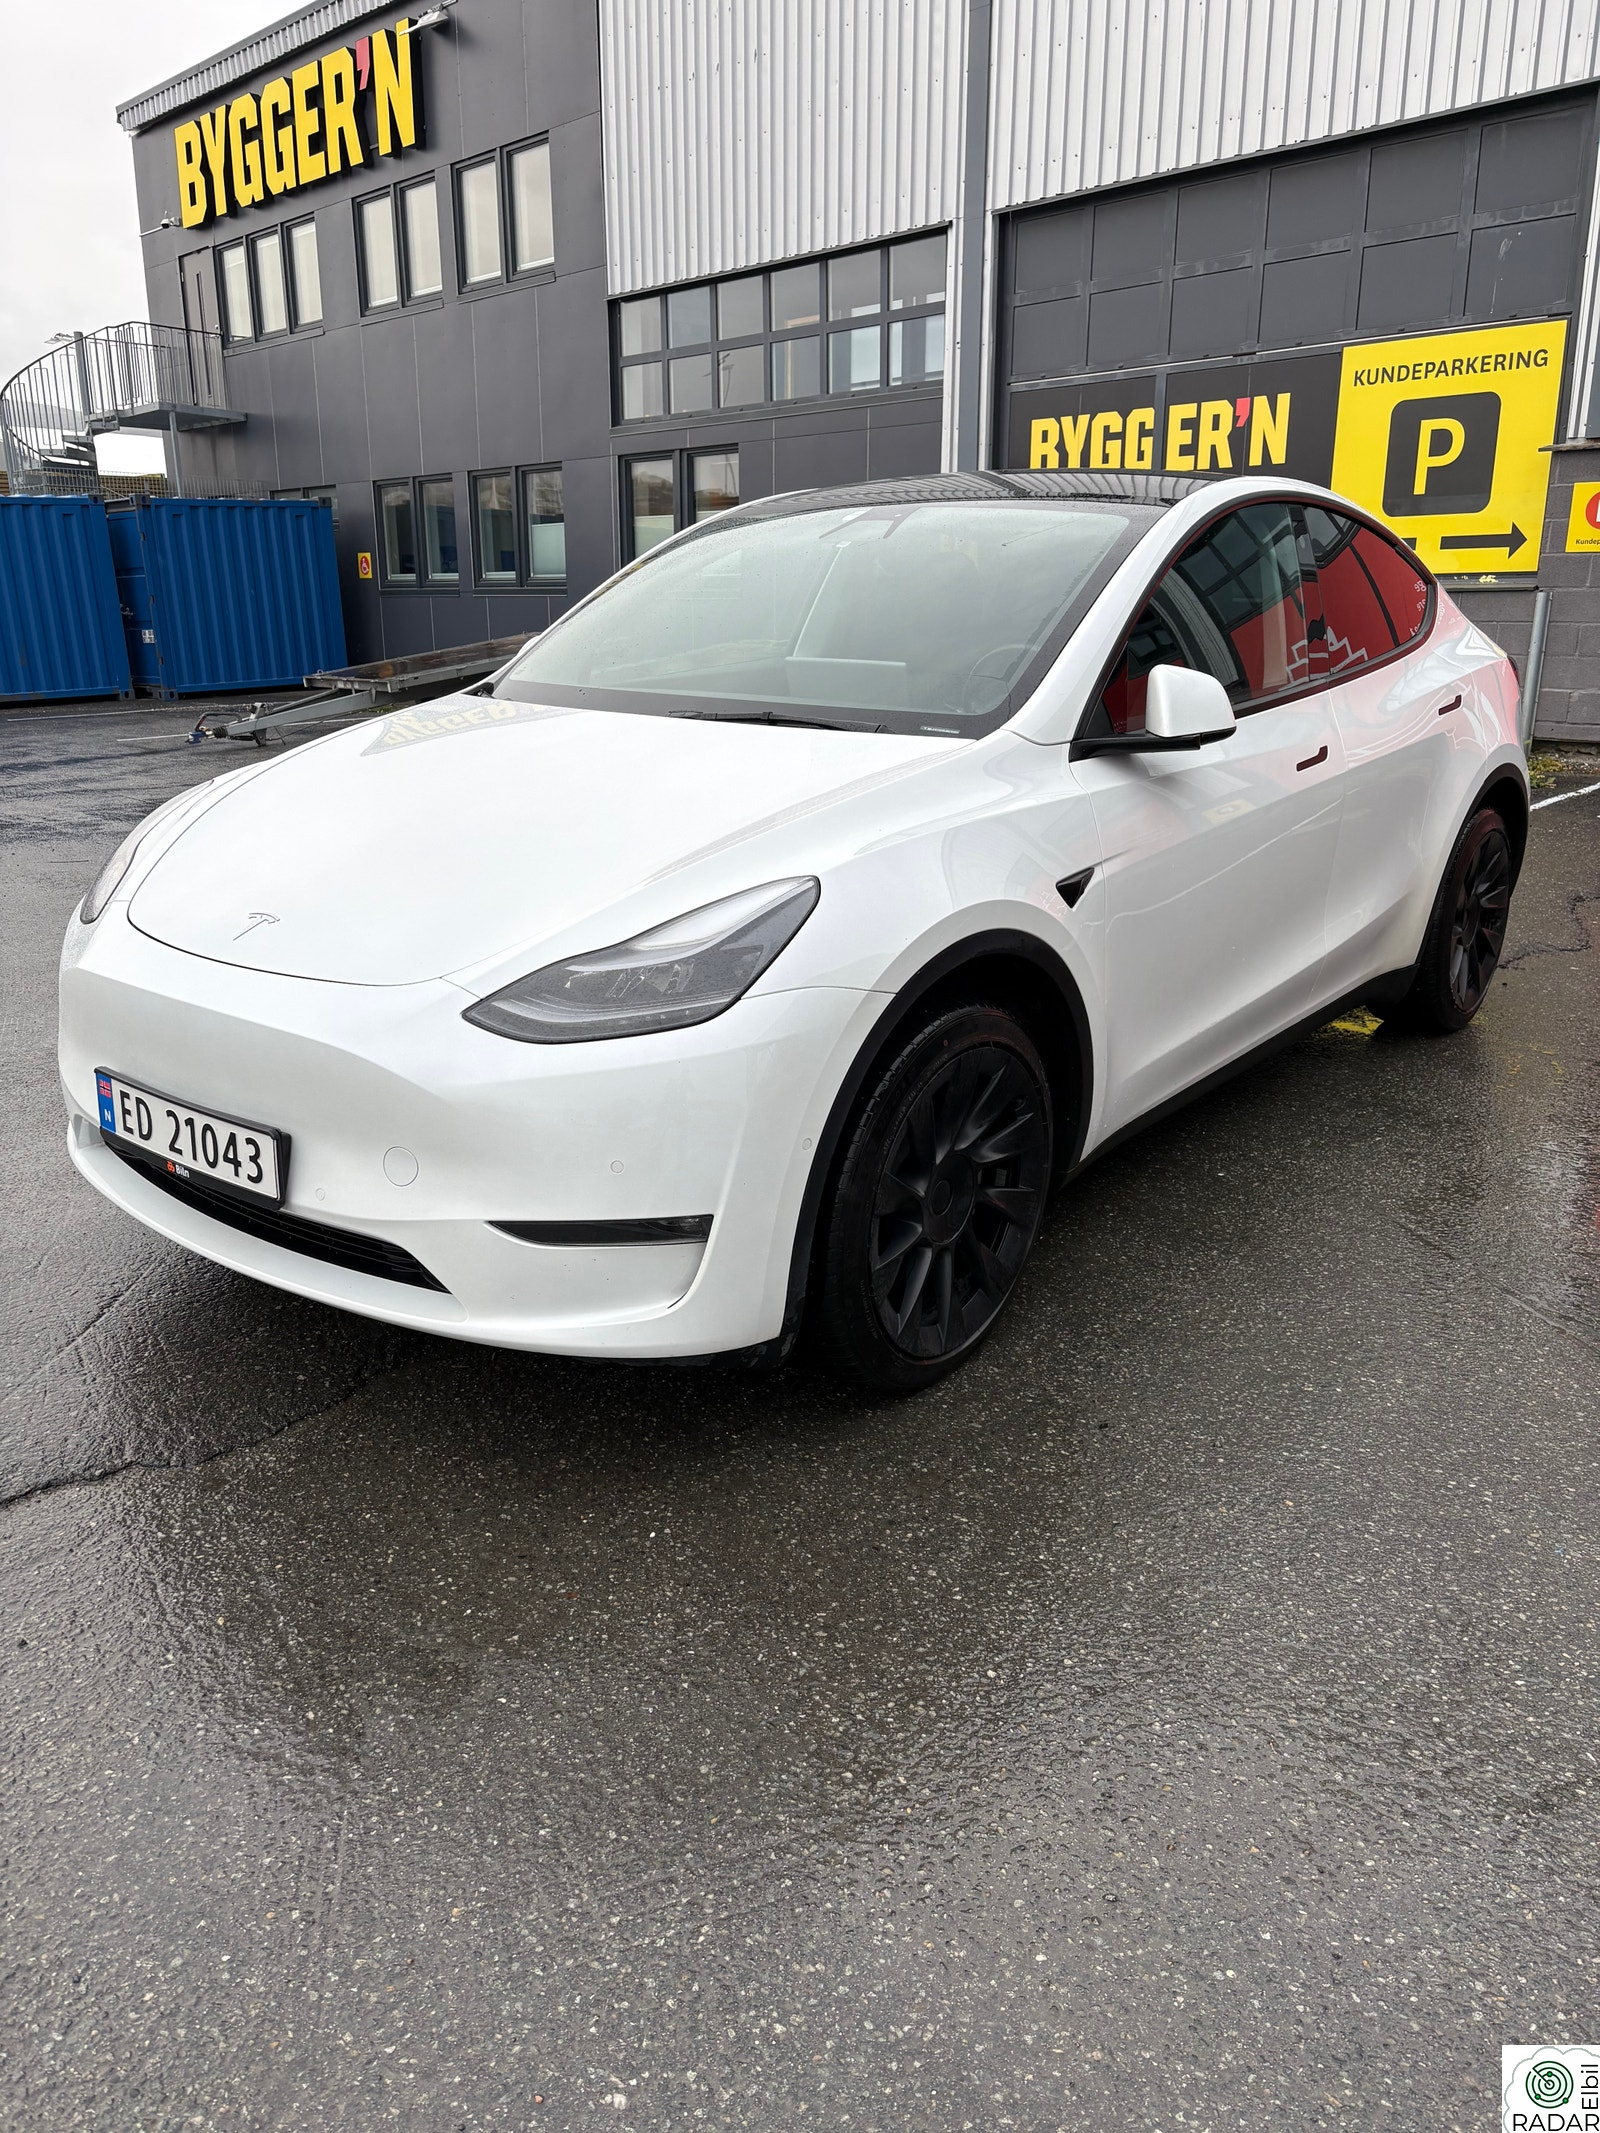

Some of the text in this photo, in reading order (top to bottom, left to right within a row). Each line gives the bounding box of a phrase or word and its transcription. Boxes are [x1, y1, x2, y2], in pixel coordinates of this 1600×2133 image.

[174, 17, 416, 230] BYGGER'N
[1353, 348, 1550, 387] KUNDEPARKERING
[1413, 417, 1466, 496] P
[104, 1108, 112, 1123] N
[119, 1089, 264, 1184] ED 21043
